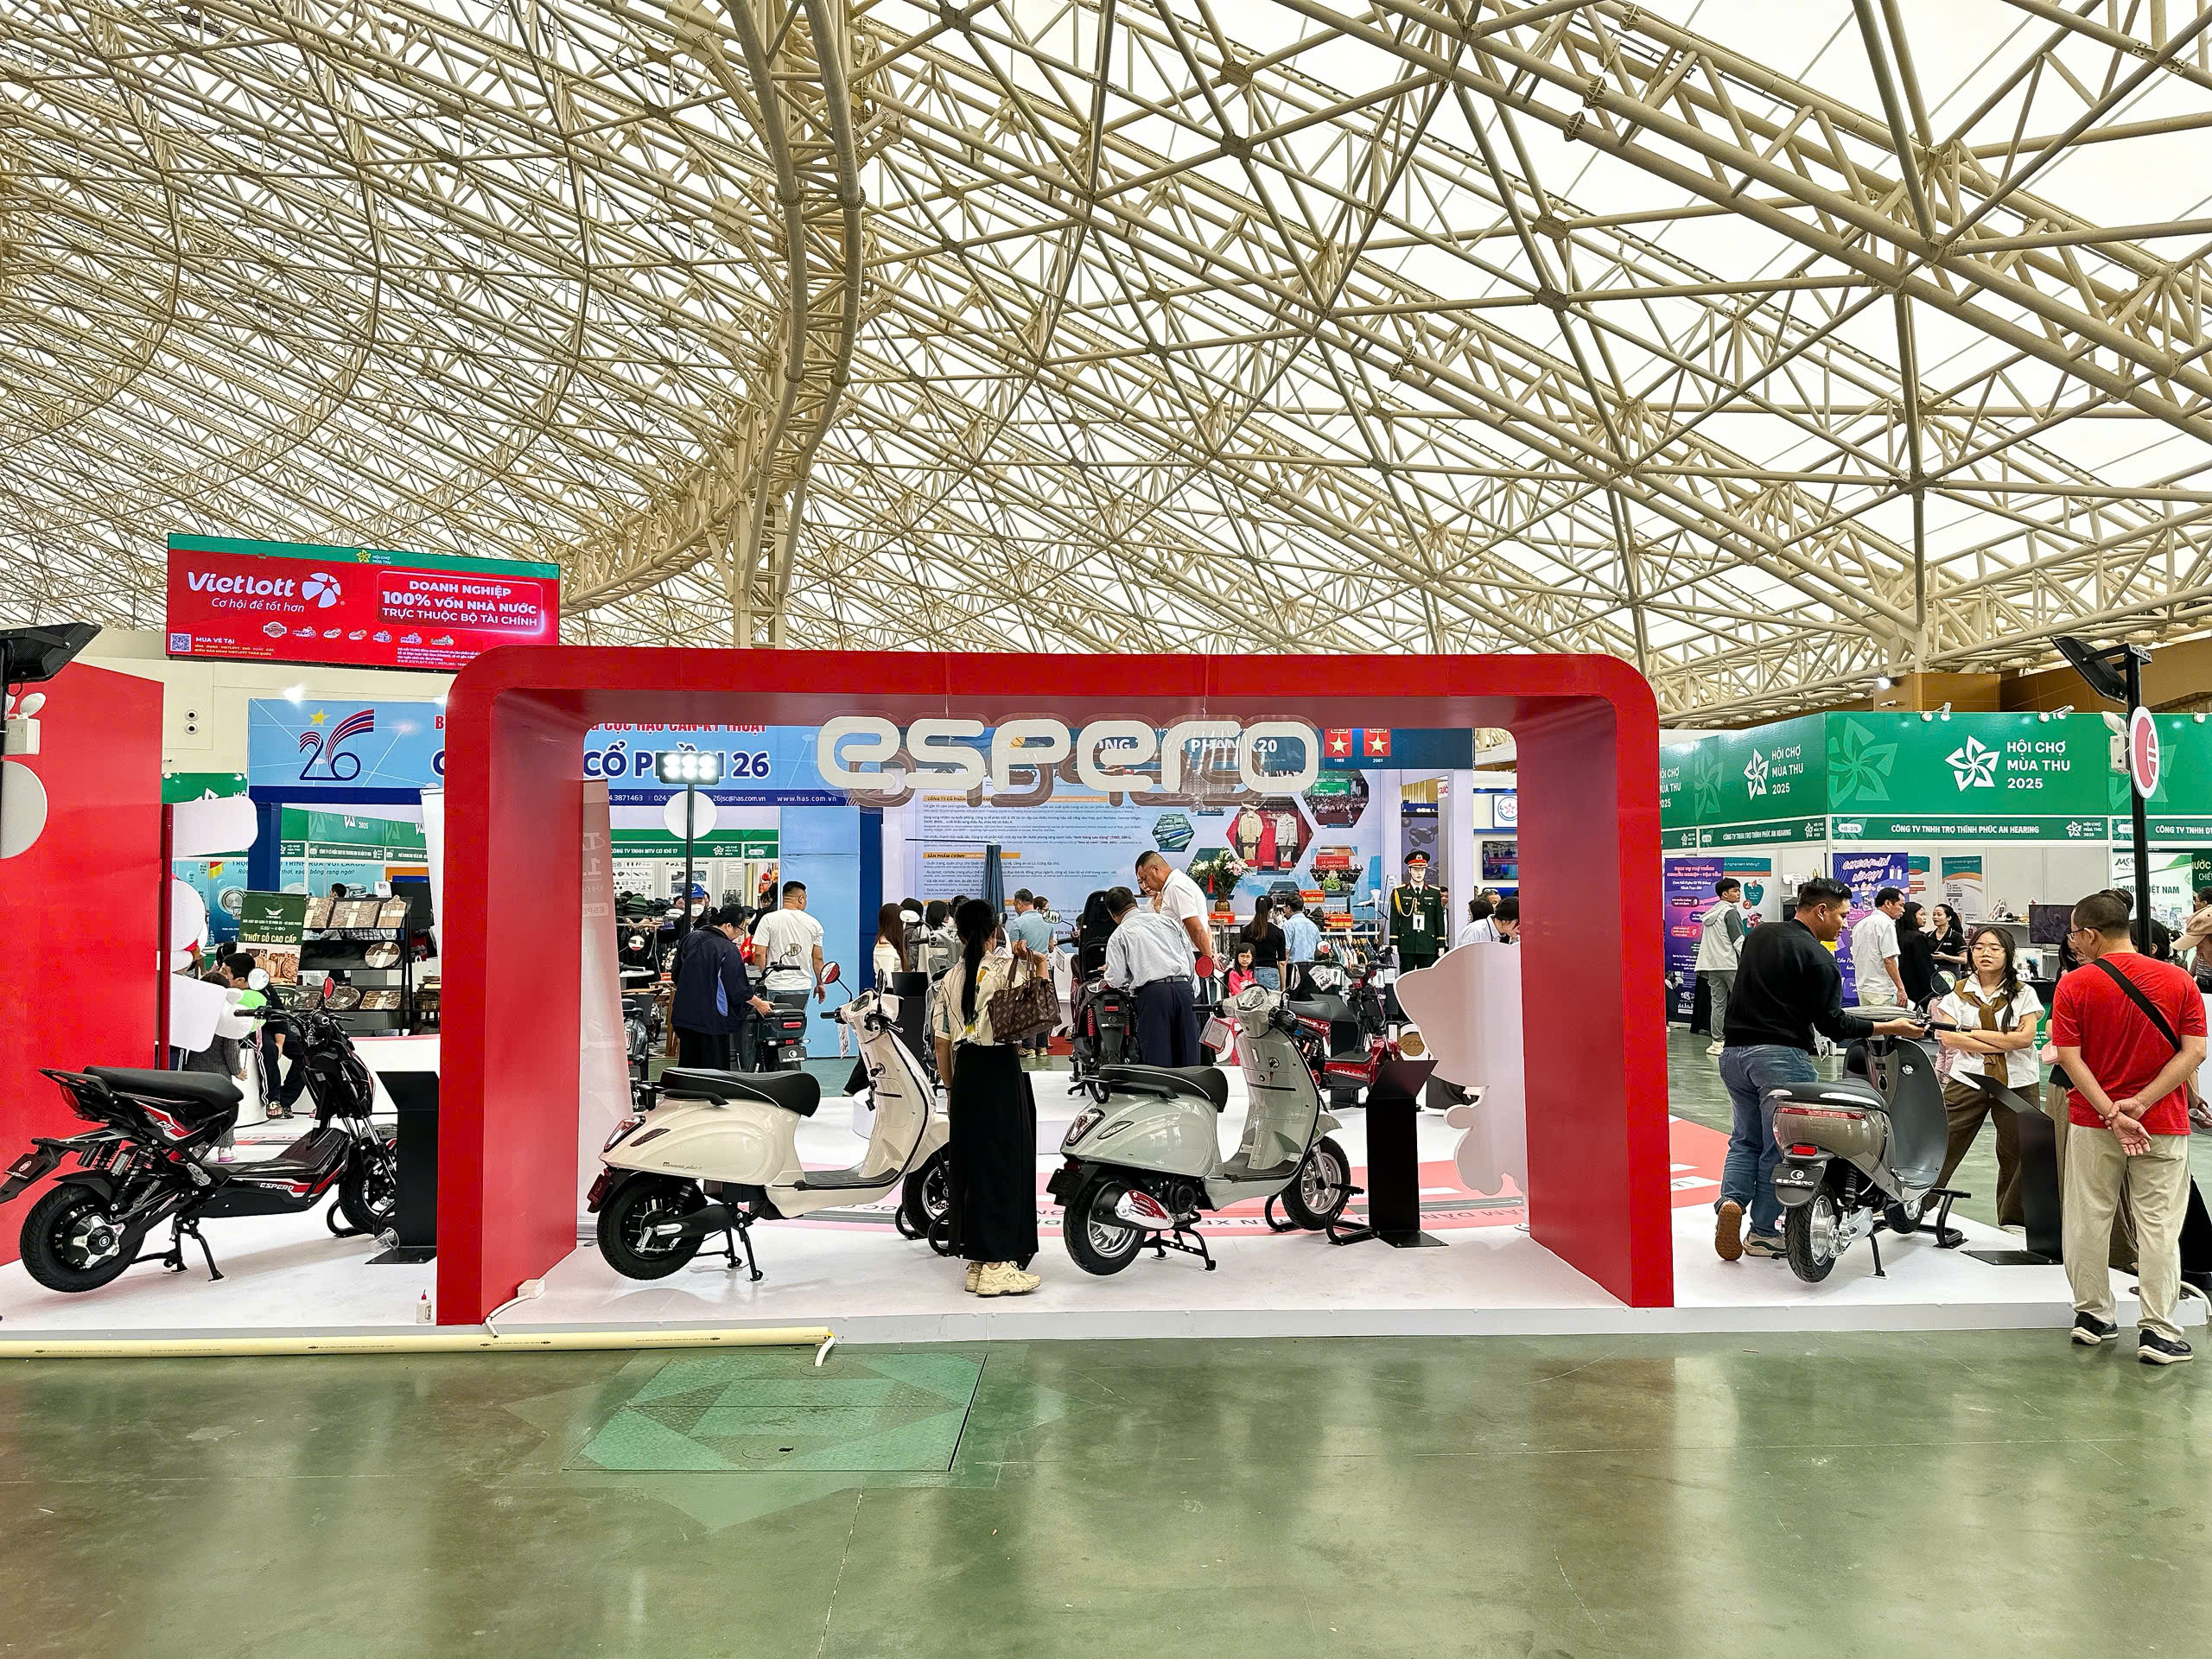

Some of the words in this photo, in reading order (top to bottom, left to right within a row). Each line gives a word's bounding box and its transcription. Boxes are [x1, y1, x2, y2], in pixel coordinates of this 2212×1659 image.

[188, 571, 296, 597] Vietlott
[409, 581, 458, 593] DOANH
[462, 585, 512, 599] NGHIỆP
[212, 597, 226, 607] Cơ
[229, 598, 247, 610] hội
[249, 599, 264, 610] để
[266, 600, 280, 611] tốt
[284, 602, 305, 612] hơn
[382, 591, 431, 607] 100%
[434, 596, 464, 610] VỐN
[467, 597, 496, 612] NHÀ
[499, 601, 537, 615] NƯỚC
[382, 607, 414, 619] TRỰC
[416, 609, 458, 622] THUỘC
[461, 612, 478, 624] BỘ
[480, 612, 498, 624] TÀI
[501, 613, 537, 627] CHÍNH
[817, 716, 1319, 792] espero
[1772, 746, 1784, 764] HỘI
[1785, 744, 1801, 761] CHỢ
[2007, 740, 2031, 756] HỘI
[2035, 740, 2066, 756] CHỢ
[584, 741, 627, 777] CỔ
[733, 752, 769, 777] 26
[2007, 758, 2039, 771] MÙA
[2042, 760, 2070, 771] THU
[1659, 768, 1668, 781] ỘI
[1668, 766, 1680, 778] CHỢ
[1772, 764, 1788, 777] MÙA
[1789, 763, 1804, 775] THU
[1670, 781, 1681, 792] THU
[1772, 783, 1790, 795] 2025
[2007, 778, 2044, 789] 2025
[1891, 824, 1910, 834] CÔNG
[1912, 826, 1921, 834] TY
[1922, 826, 1940, 834] TNHH
[1942, 825, 1956, 836] TRỢ
[1957, 823, 1977, 834] THÍNH
[1978, 824, 1997, 834] PHÚC
[2009, 826, 2039, 835] HEARING
[2155, 825, 2174, 833] CÔNG
[244, 933, 261, 942] THỚT
[261, 932, 270, 942] GỖ
[271, 935, 284, 943] CAO
[285, 933, 297, 944] CẤP
[260, 1182, 295, 1192] ESPERO
